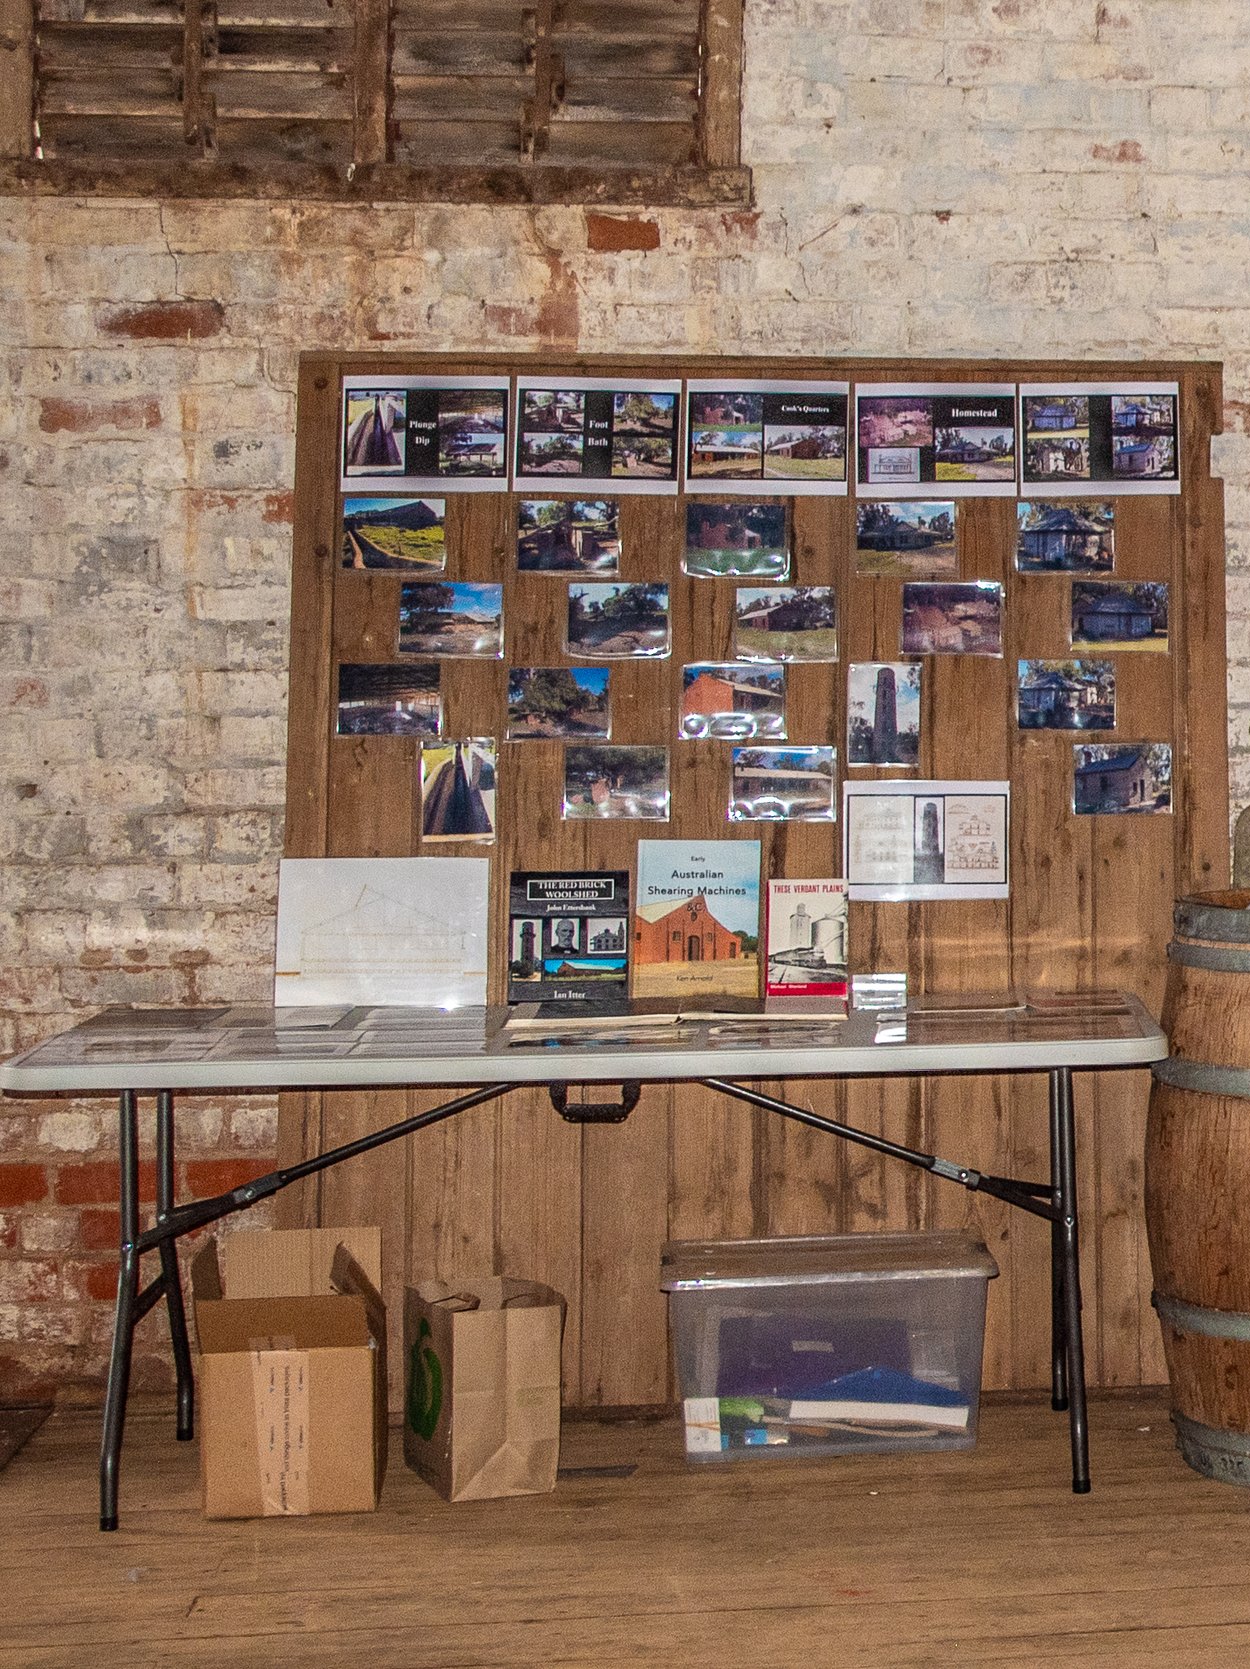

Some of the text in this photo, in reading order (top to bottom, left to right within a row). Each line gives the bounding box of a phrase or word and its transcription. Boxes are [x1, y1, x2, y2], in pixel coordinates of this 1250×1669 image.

[951, 408, 998, 418] Homestead
[409, 420, 437, 430] Plunge
[589, 420, 609, 429] Foot
[415, 436, 430, 446] Dip
[588, 437, 609, 447] Bath
[671, 869, 724, 879] Australian
[538, 880, 606, 889] THE RED BRICK
[774, 884, 844, 894] THESE VERDANT PLAINS
[545, 890, 599, 898] WOOLSHED
[647, 885, 747, 898] Shearing Machines
[546, 904, 562, 912] John
[553, 990, 587, 999] Ian Itter
